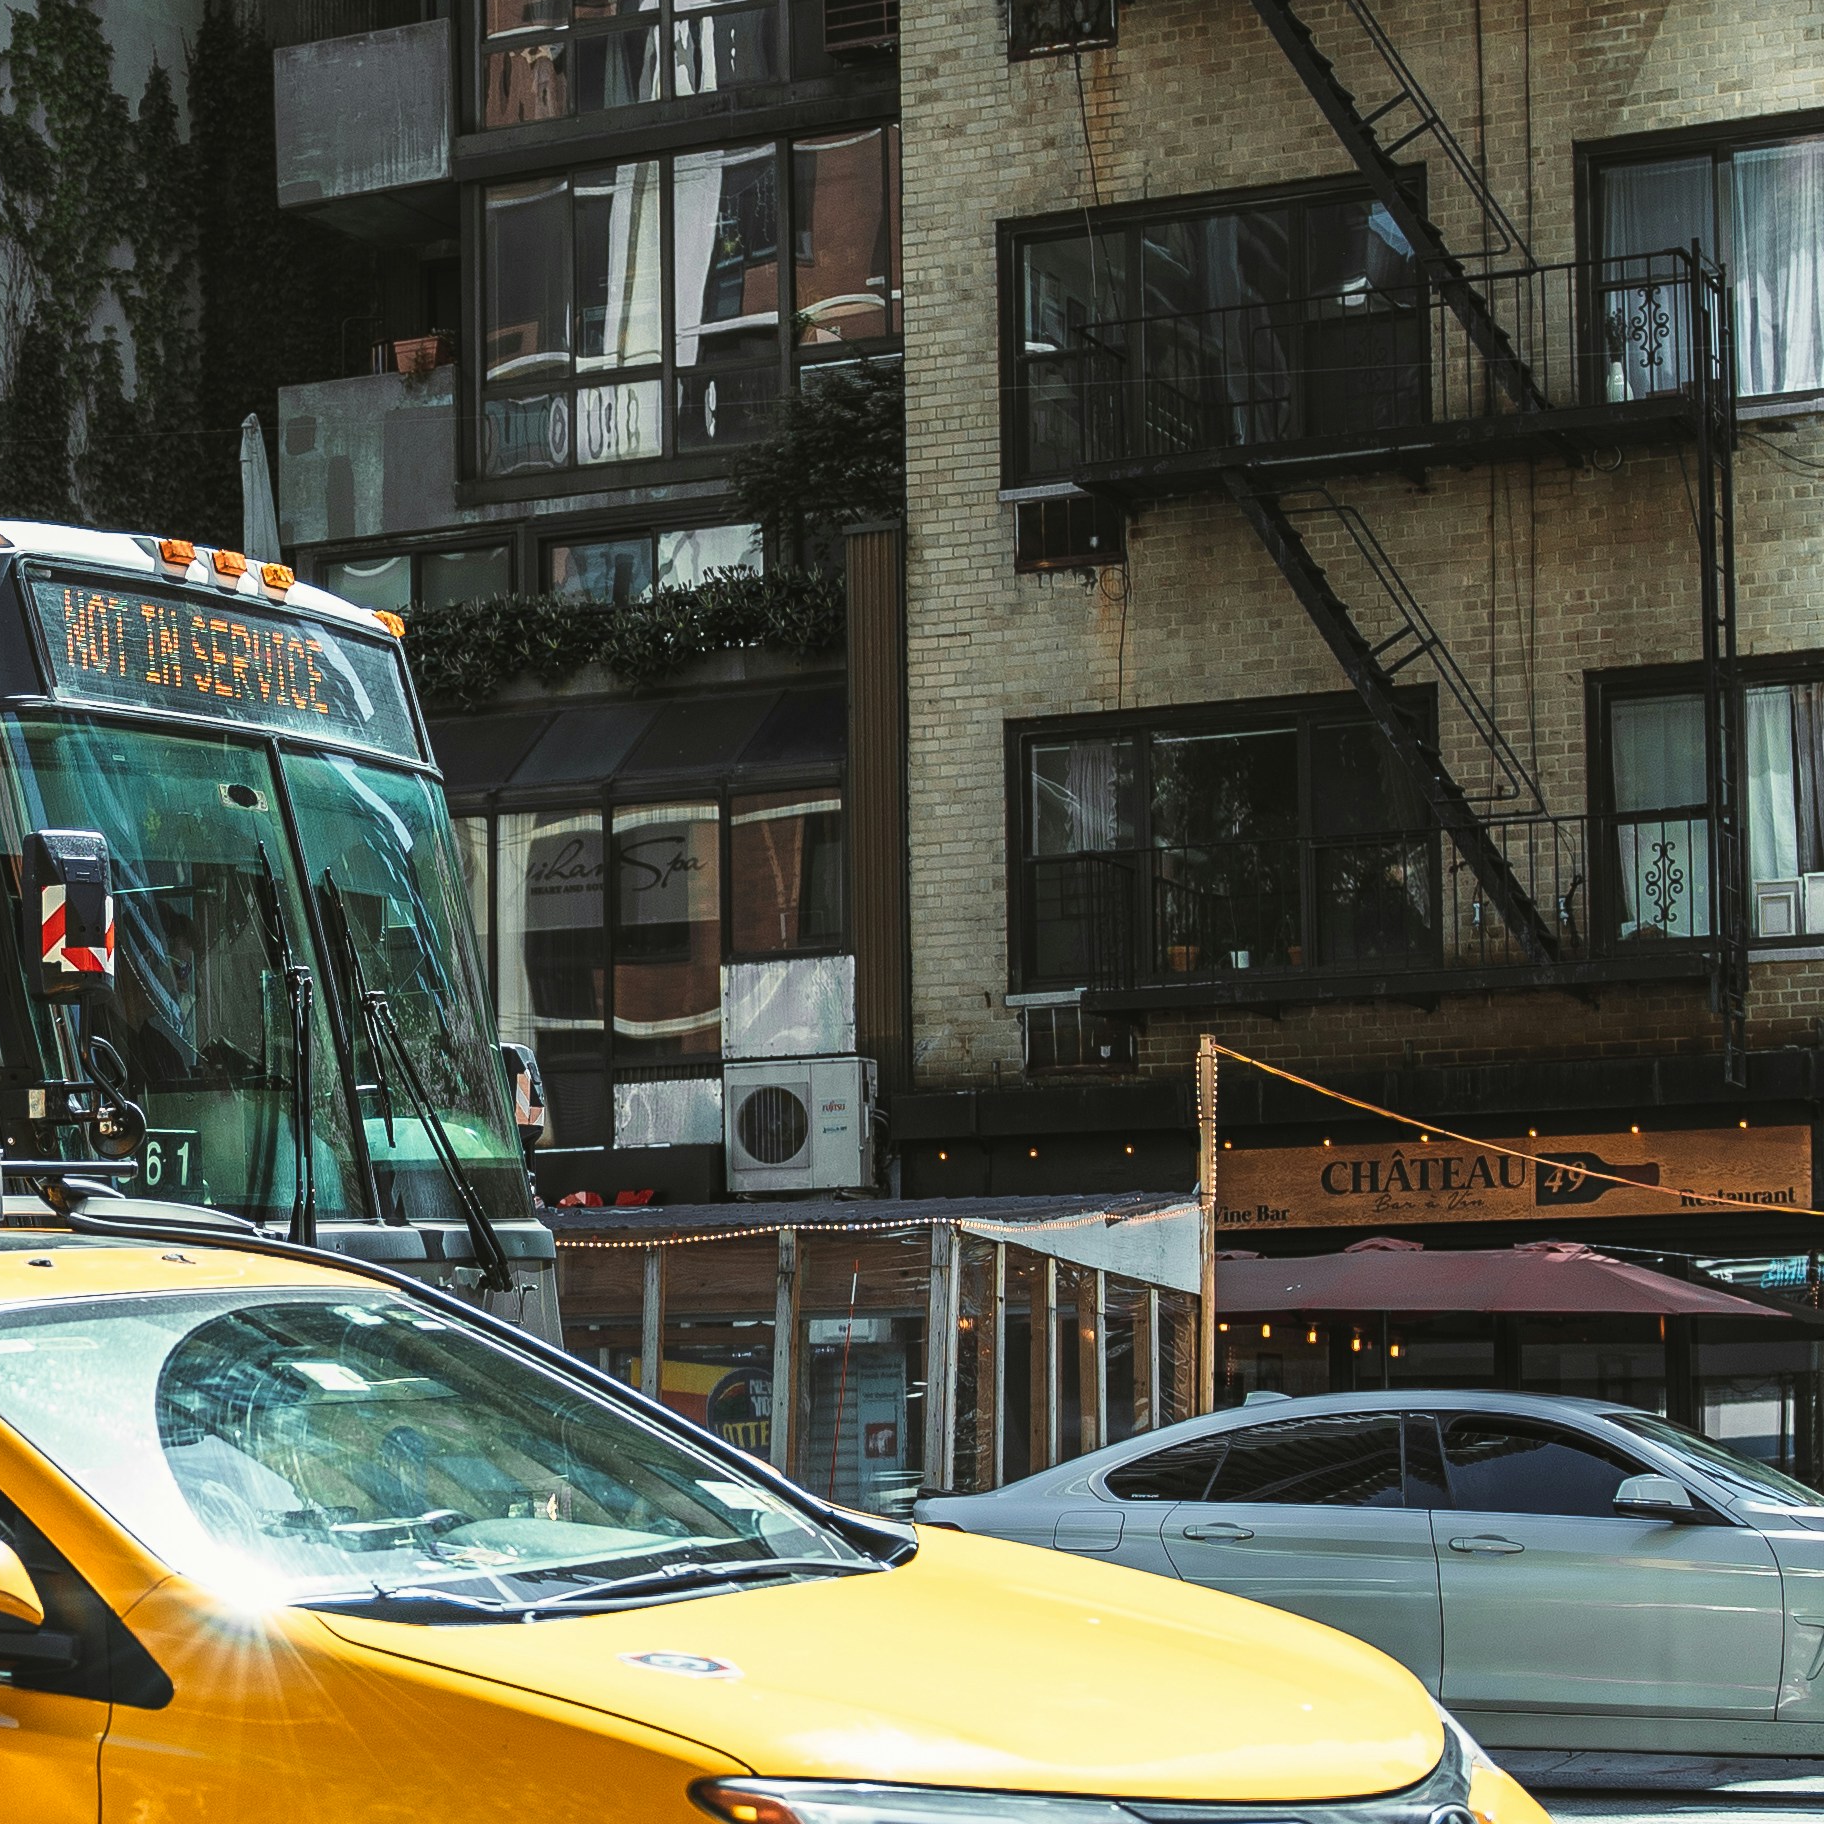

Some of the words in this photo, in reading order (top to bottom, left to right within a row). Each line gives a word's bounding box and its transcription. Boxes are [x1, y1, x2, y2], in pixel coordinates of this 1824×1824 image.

[64, 588, 128, 676] NOT
[141, 603, 182, 687] IN
[191, 615, 329, 714] SERVICE
[619, 836, 707, 892] Spa
[1321, 1149, 1526, 1195] CHÂTEAU
[1544, 1161, 1587, 1193] 49
[1256, 1204, 1290, 1222] Bar
[1375, 1194, 1415, 1213] Bar
[1447, 1191, 1485, 1210] Vin
[1680, 1187, 1797, 1207] Restaurant
